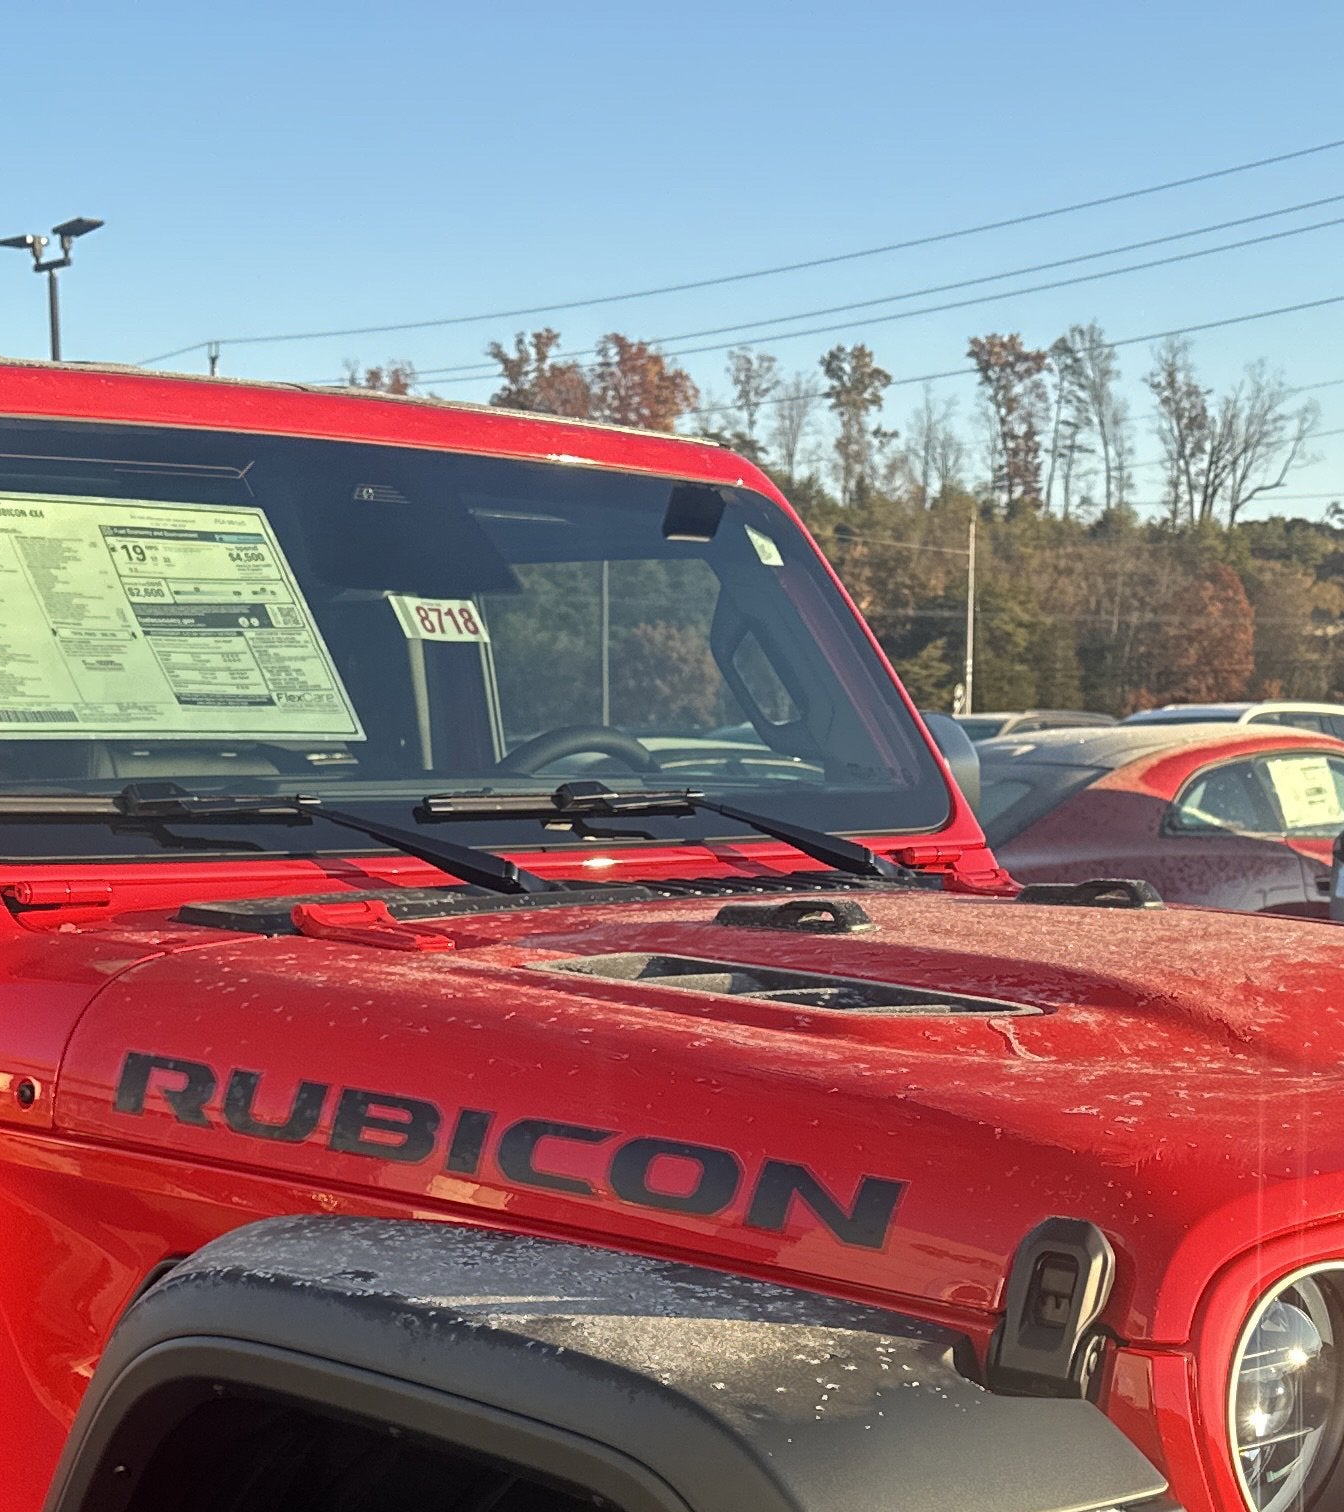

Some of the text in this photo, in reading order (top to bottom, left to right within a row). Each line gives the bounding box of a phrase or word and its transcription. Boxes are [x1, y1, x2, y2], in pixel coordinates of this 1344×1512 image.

[120, 544, 147, 562] 19
[228, 552, 265, 562] $4,500
[415, 606, 479, 635] 8718
[276, 692, 335, 703] FlexCare
[113, 1050, 910, 1251] RUBICON
